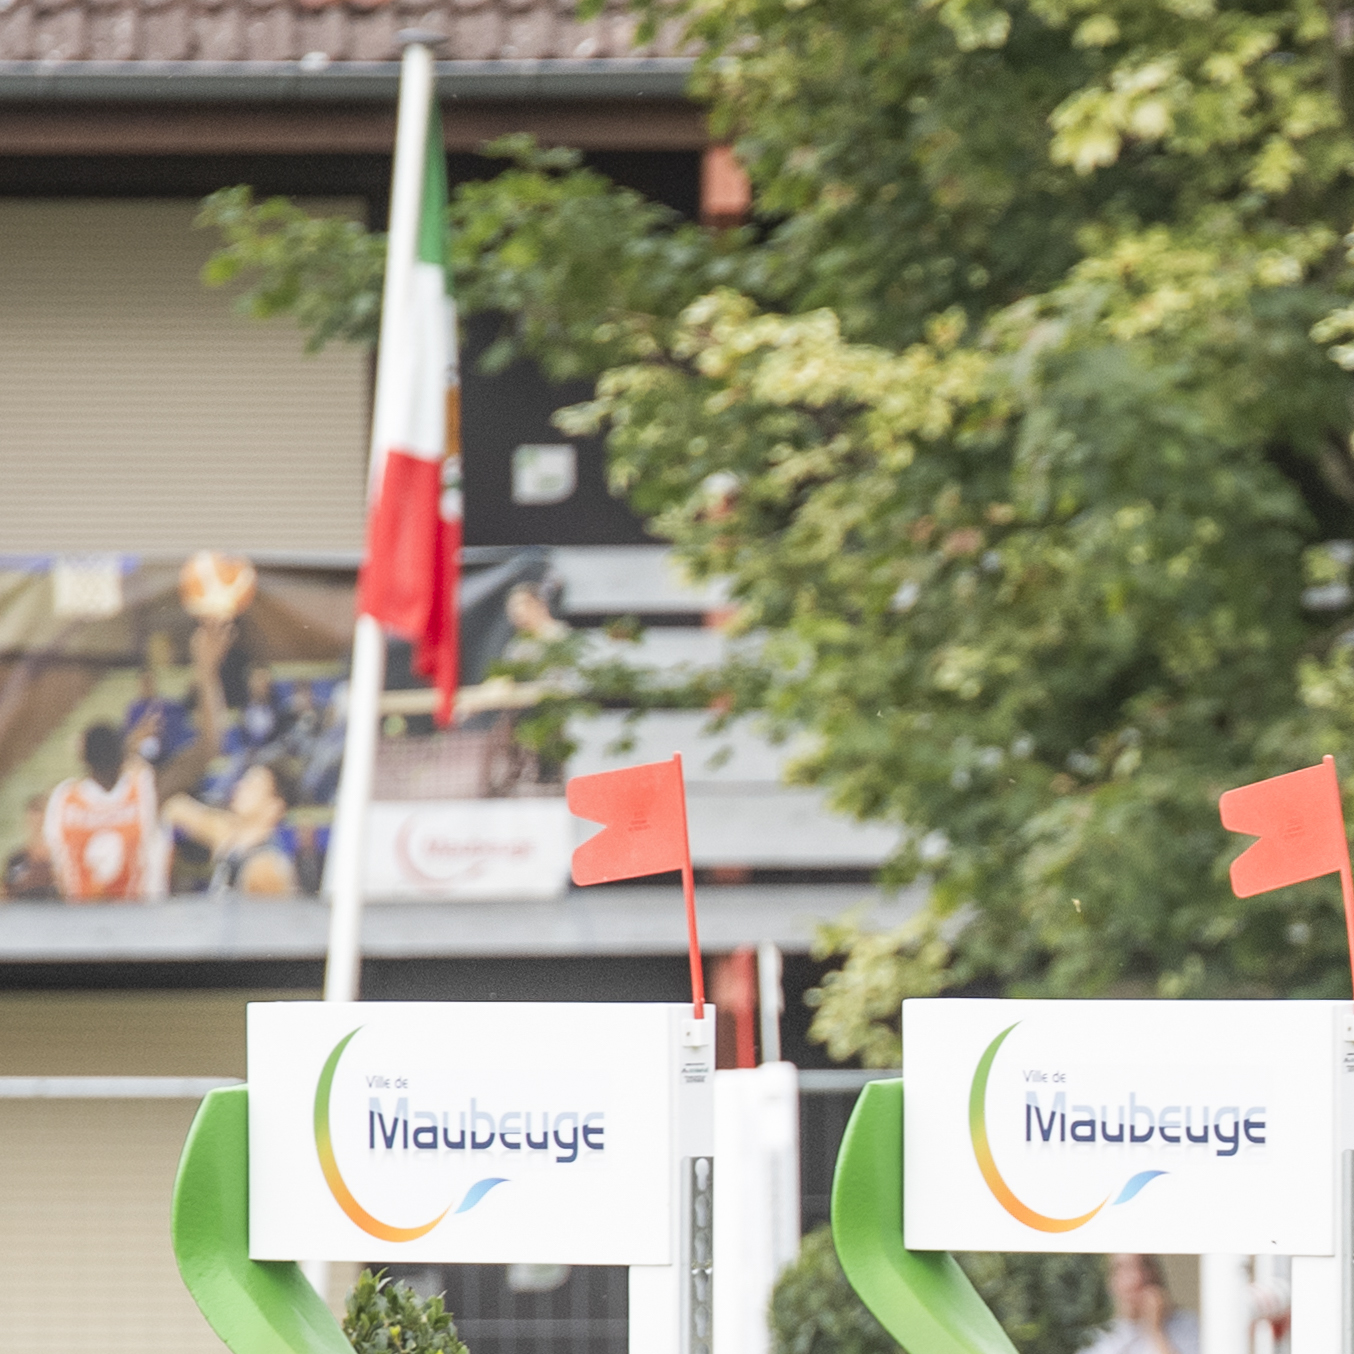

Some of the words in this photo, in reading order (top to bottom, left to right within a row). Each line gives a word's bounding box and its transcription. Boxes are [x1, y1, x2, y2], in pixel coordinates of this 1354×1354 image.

[365, 1075, 391, 1089] Ville
[394, 1075, 408, 1089] de
[1022, 1070, 1048, 1083] Ville
[1052, 1070, 1066, 1083] de
[368, 1097, 605, 1163] Maubeuge
[1025, 1091, 1267, 1157] Maubeuge
